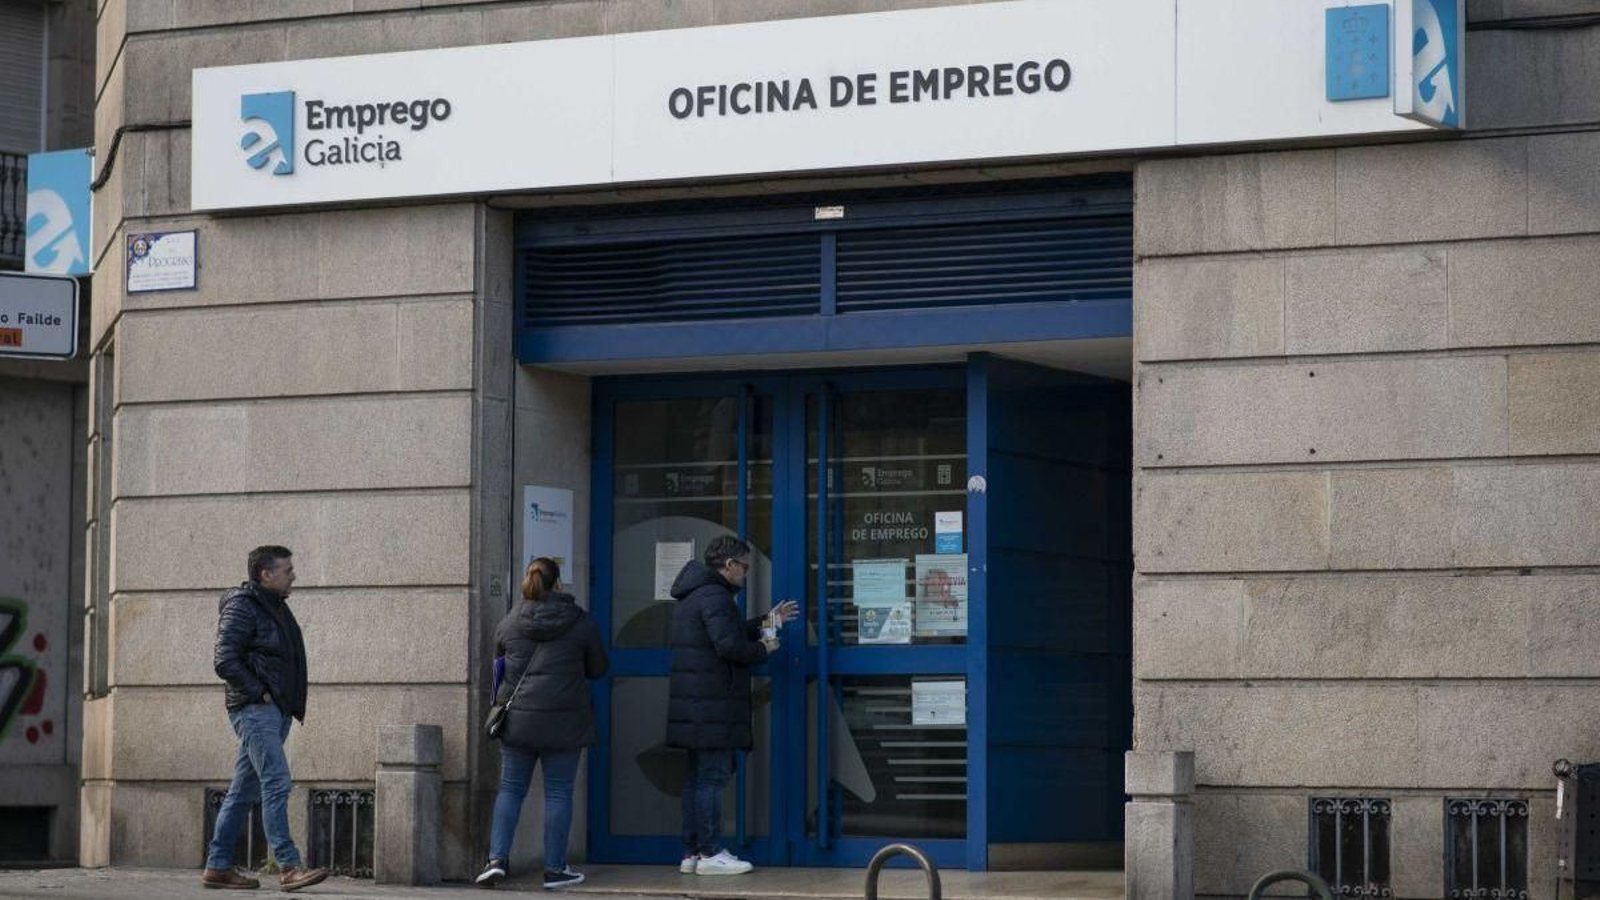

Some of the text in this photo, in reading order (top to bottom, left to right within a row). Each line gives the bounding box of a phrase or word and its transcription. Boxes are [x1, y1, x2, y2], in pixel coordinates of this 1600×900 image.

[668, 58, 1072, 120] OFICINA DE EMPREGO
[305, 98, 451, 134] Emprego
[304, 135, 402, 166] Galicia
[18, 312, 62, 326] Failde
[863, 511, 914, 524] OFICINA
[852, 527, 929, 541] DE EMPREGO
